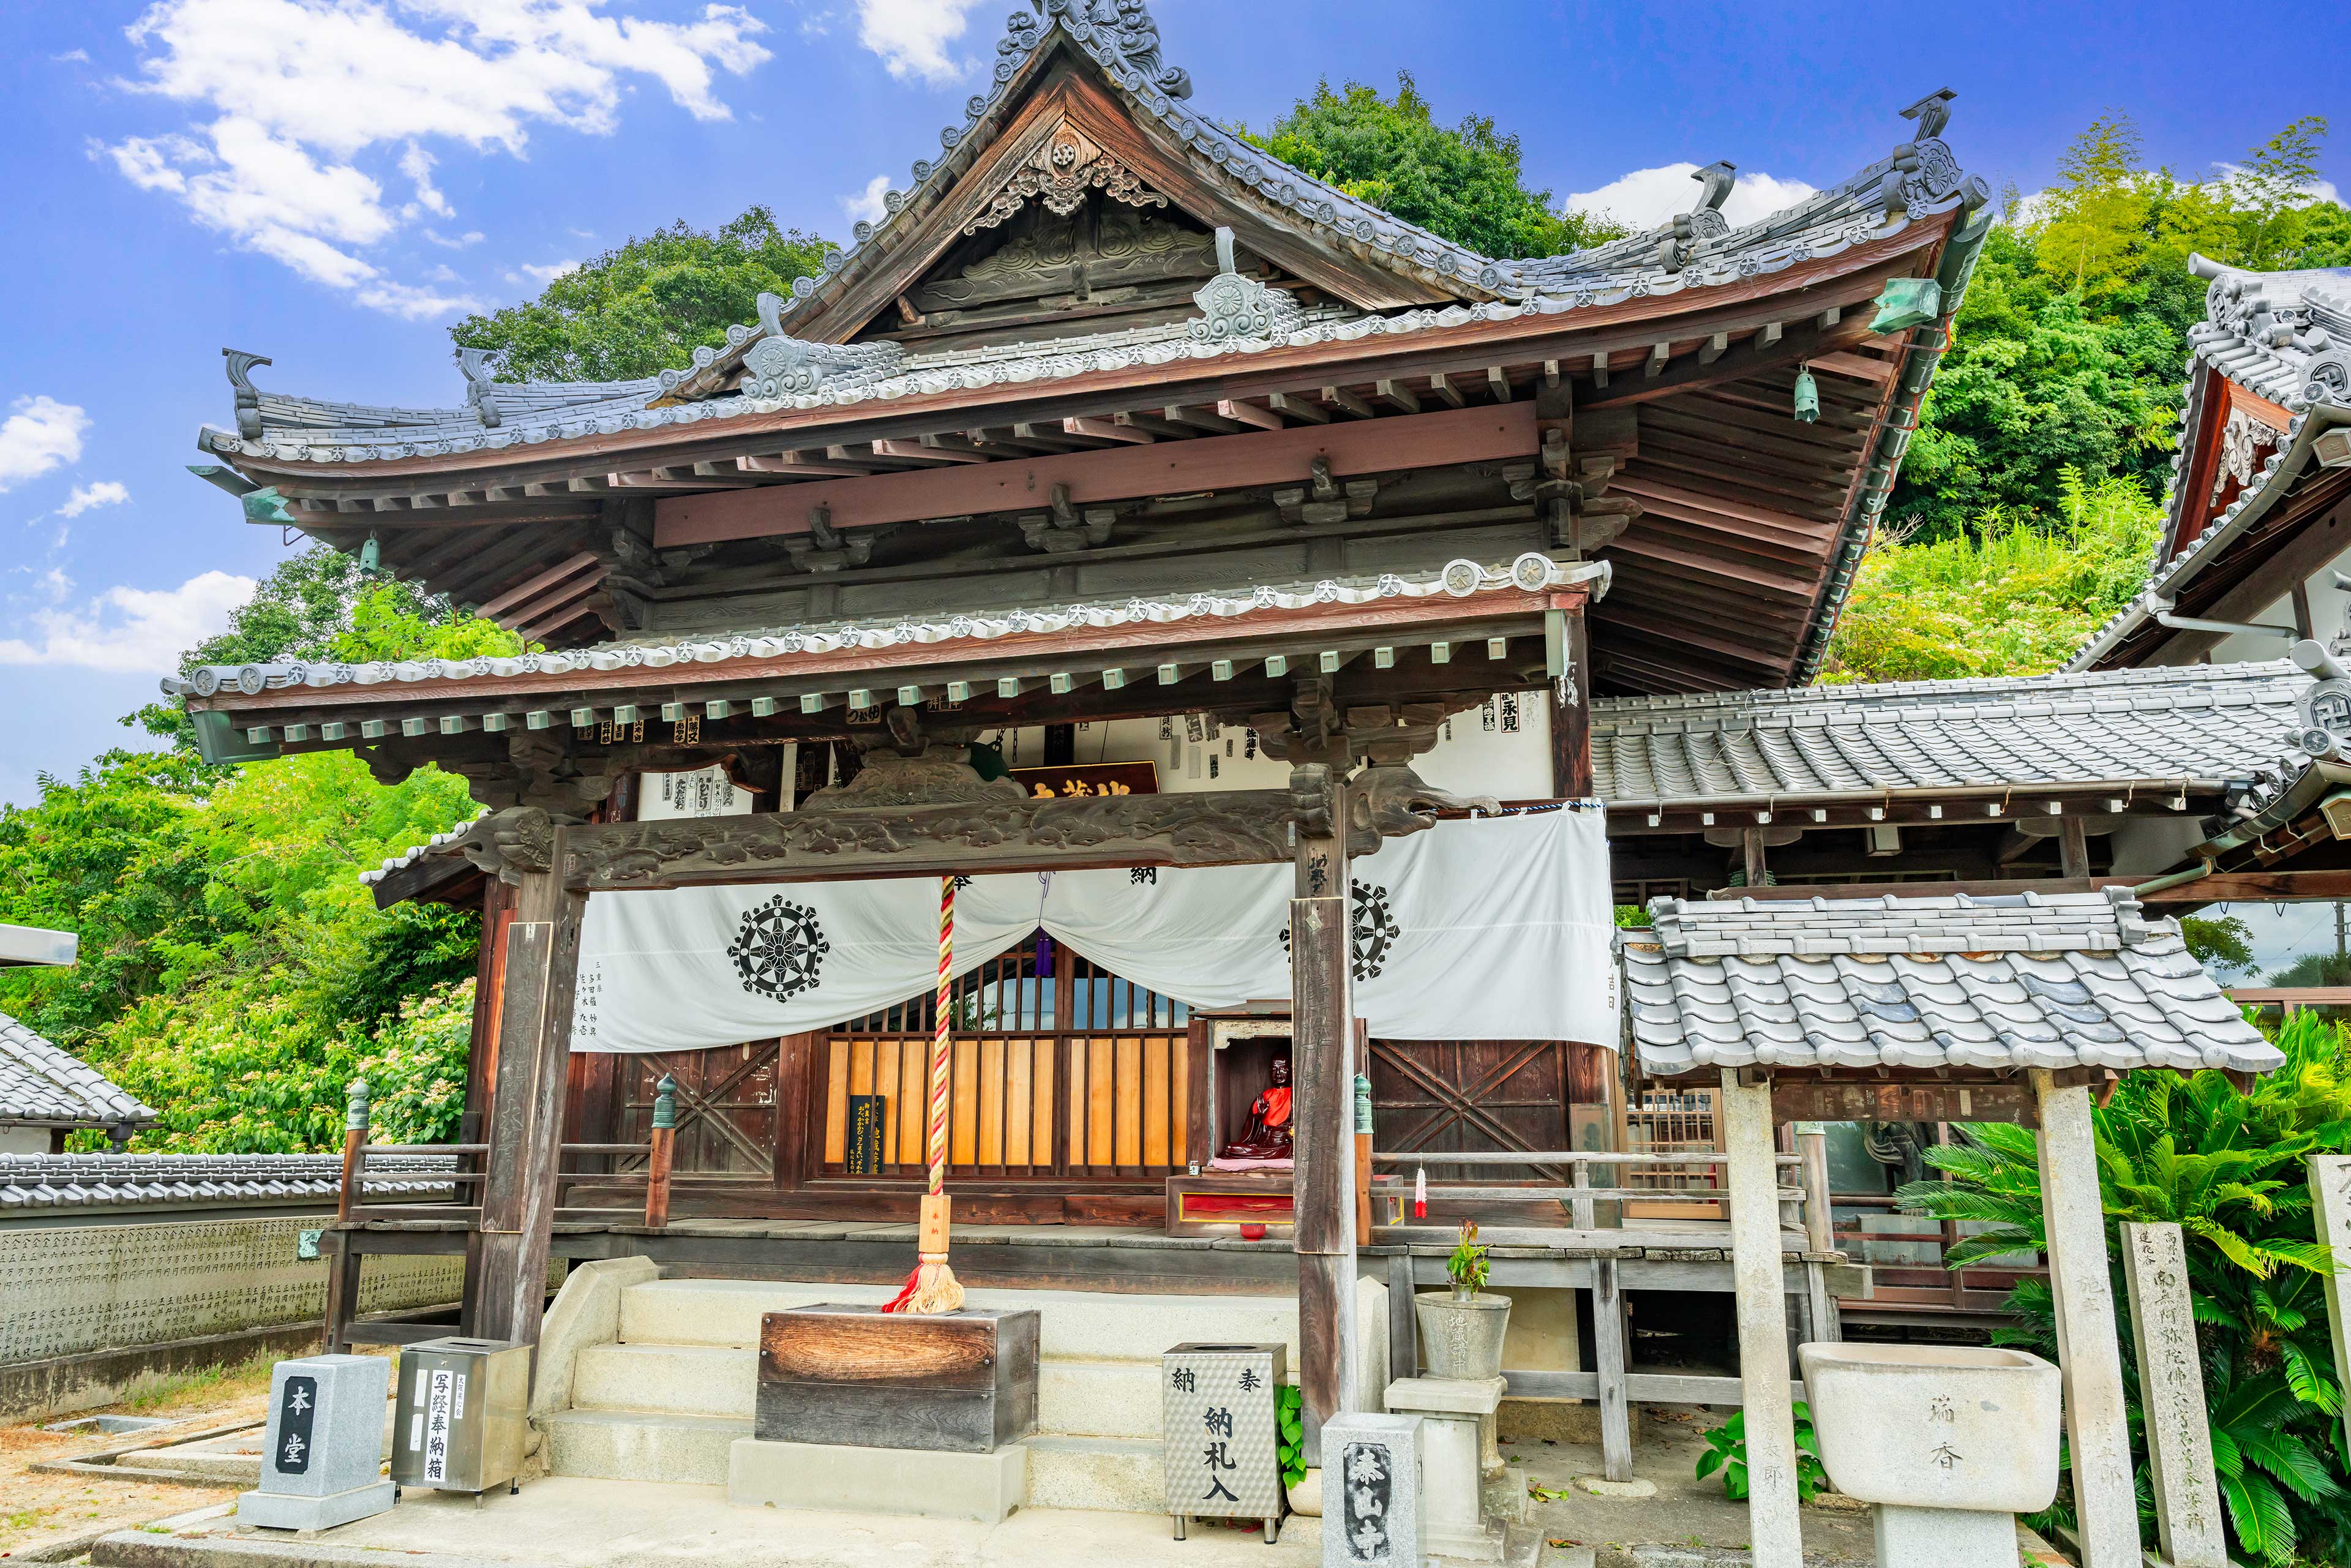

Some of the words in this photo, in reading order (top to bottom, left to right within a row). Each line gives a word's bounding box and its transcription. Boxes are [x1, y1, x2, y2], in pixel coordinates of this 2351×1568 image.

[1131, 867, 1157, 885] 納
[1171, 1367, 1195, 1394] 納
[1238, 1368, 1261, 1394] 奉
[1449, 1313, 1469, 1375] 地蔵講中
[285, 1386, 312, 1464] 本堂
[427, 1373, 449, 1480] 写経奉納箱
[1202, 1406, 1240, 1503] 納札入
[1929, 1394, 1963, 1470] 瑞香
[1349, 1447, 1387, 1561] 泰山寺
